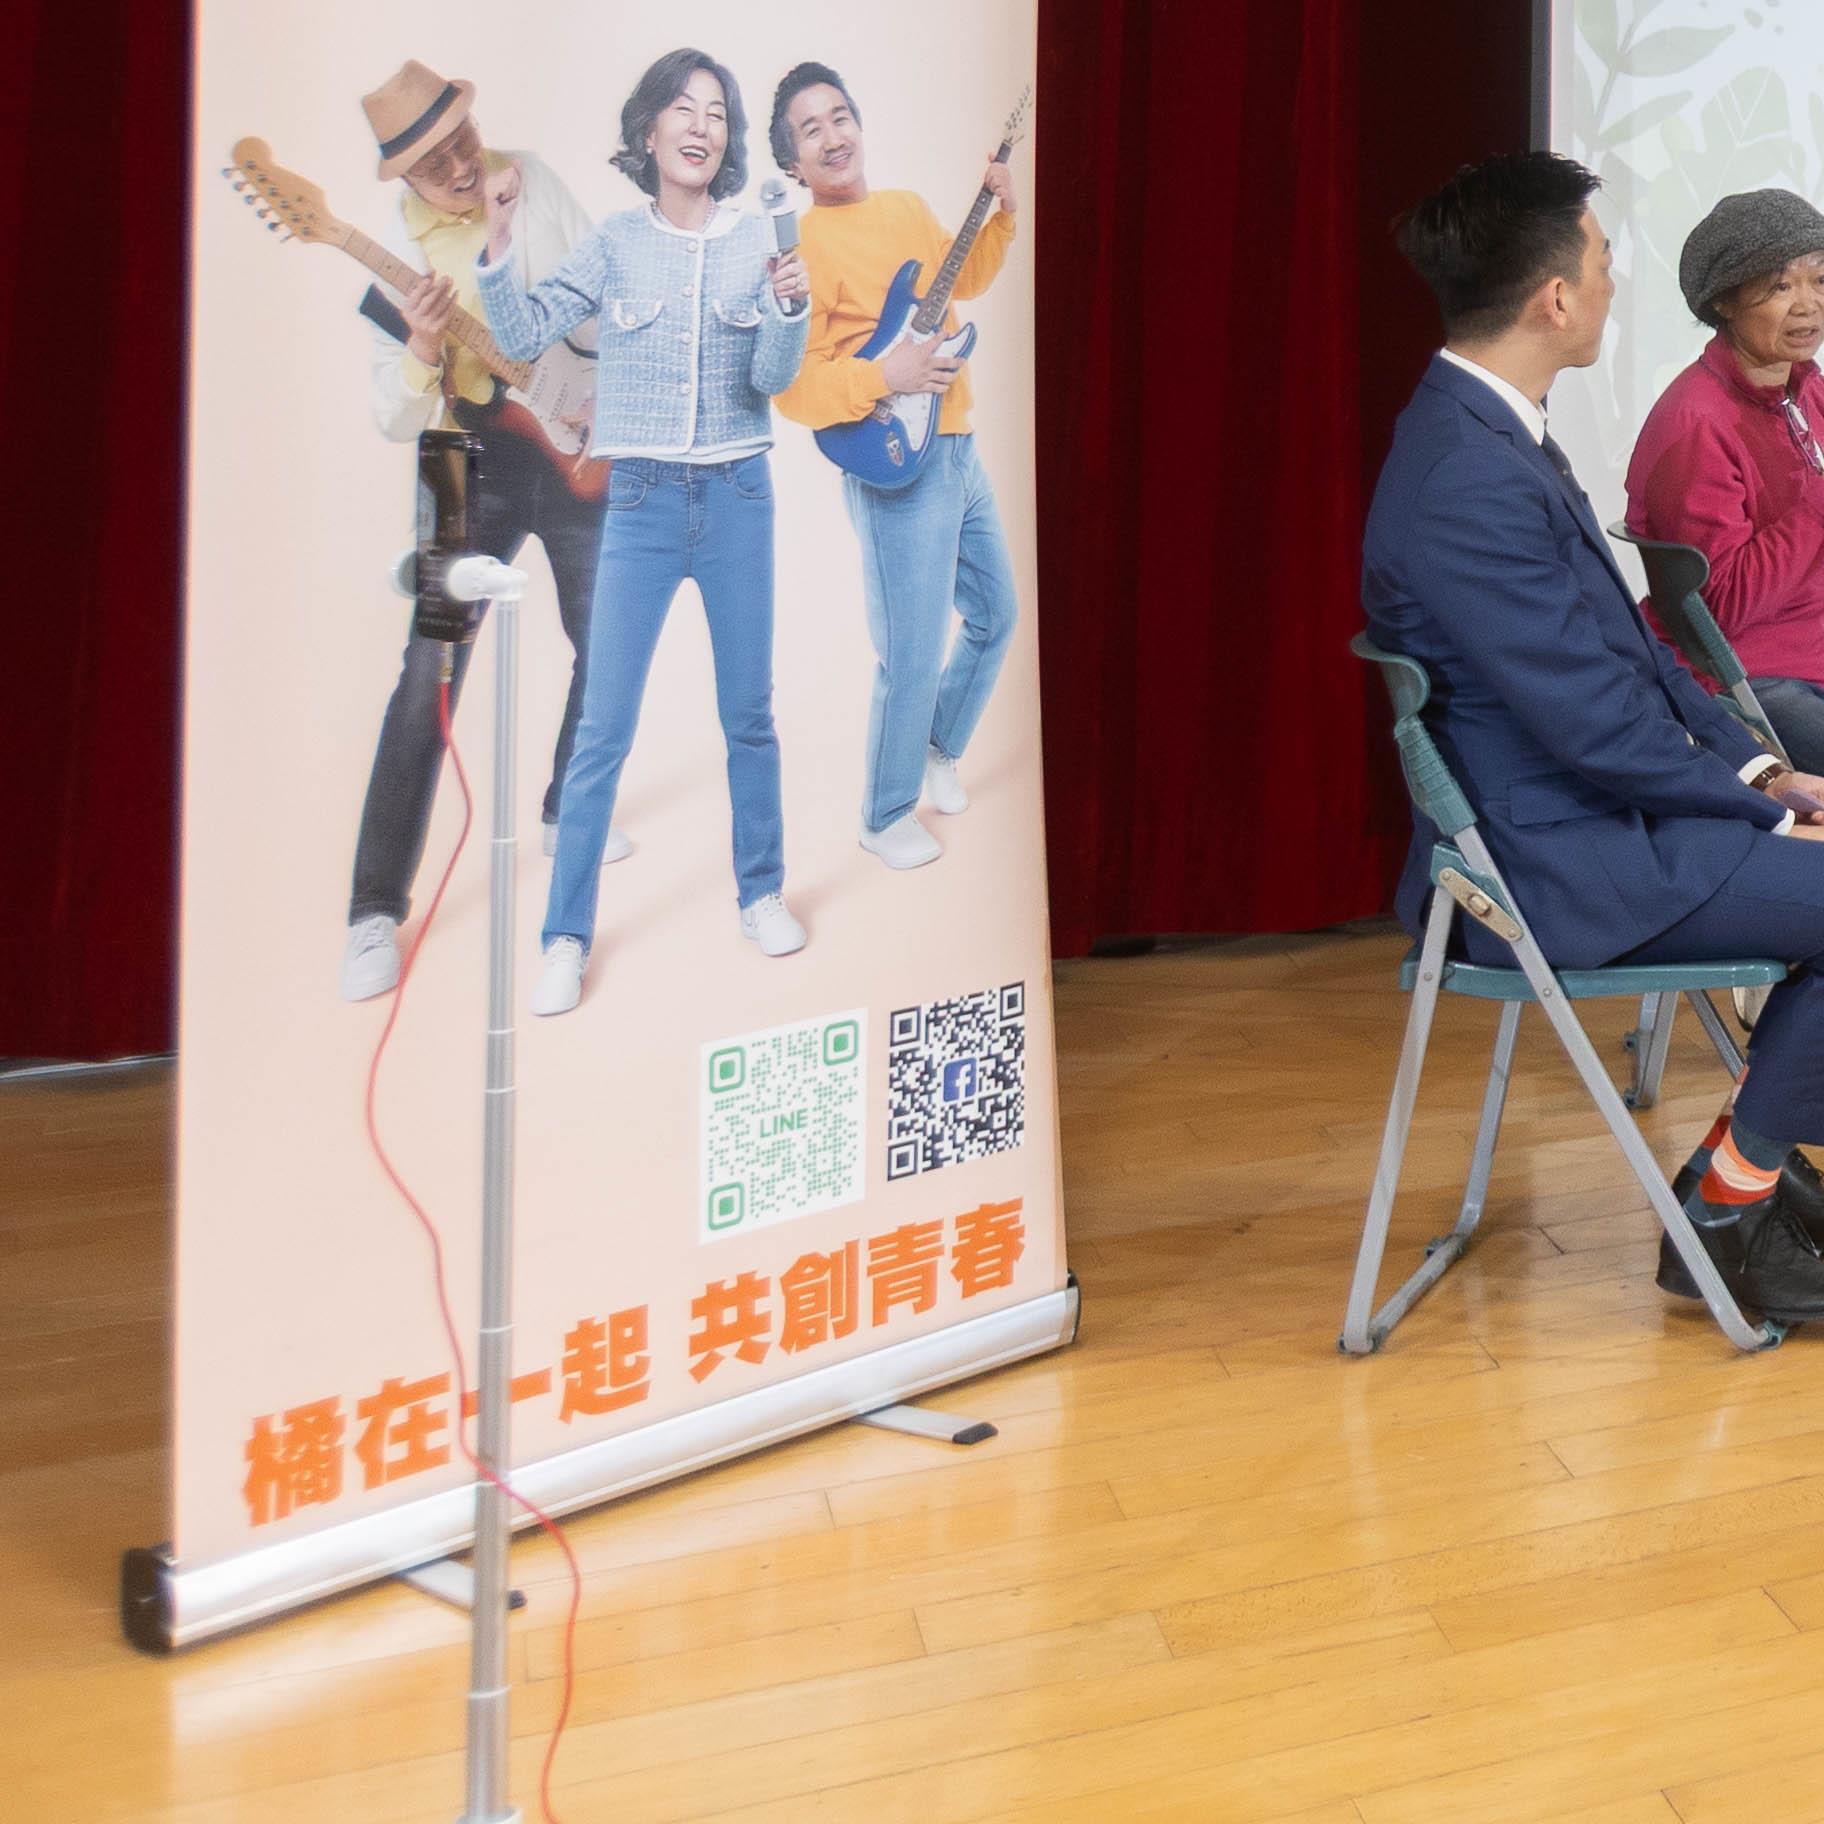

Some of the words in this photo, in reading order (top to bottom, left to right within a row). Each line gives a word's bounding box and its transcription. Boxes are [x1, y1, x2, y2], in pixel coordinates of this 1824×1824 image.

[760, 1107, 808, 1138] LINE
[242, 1303, 652, 1527] 橘在一起
[689, 1196, 1027, 1383] 共創青春
